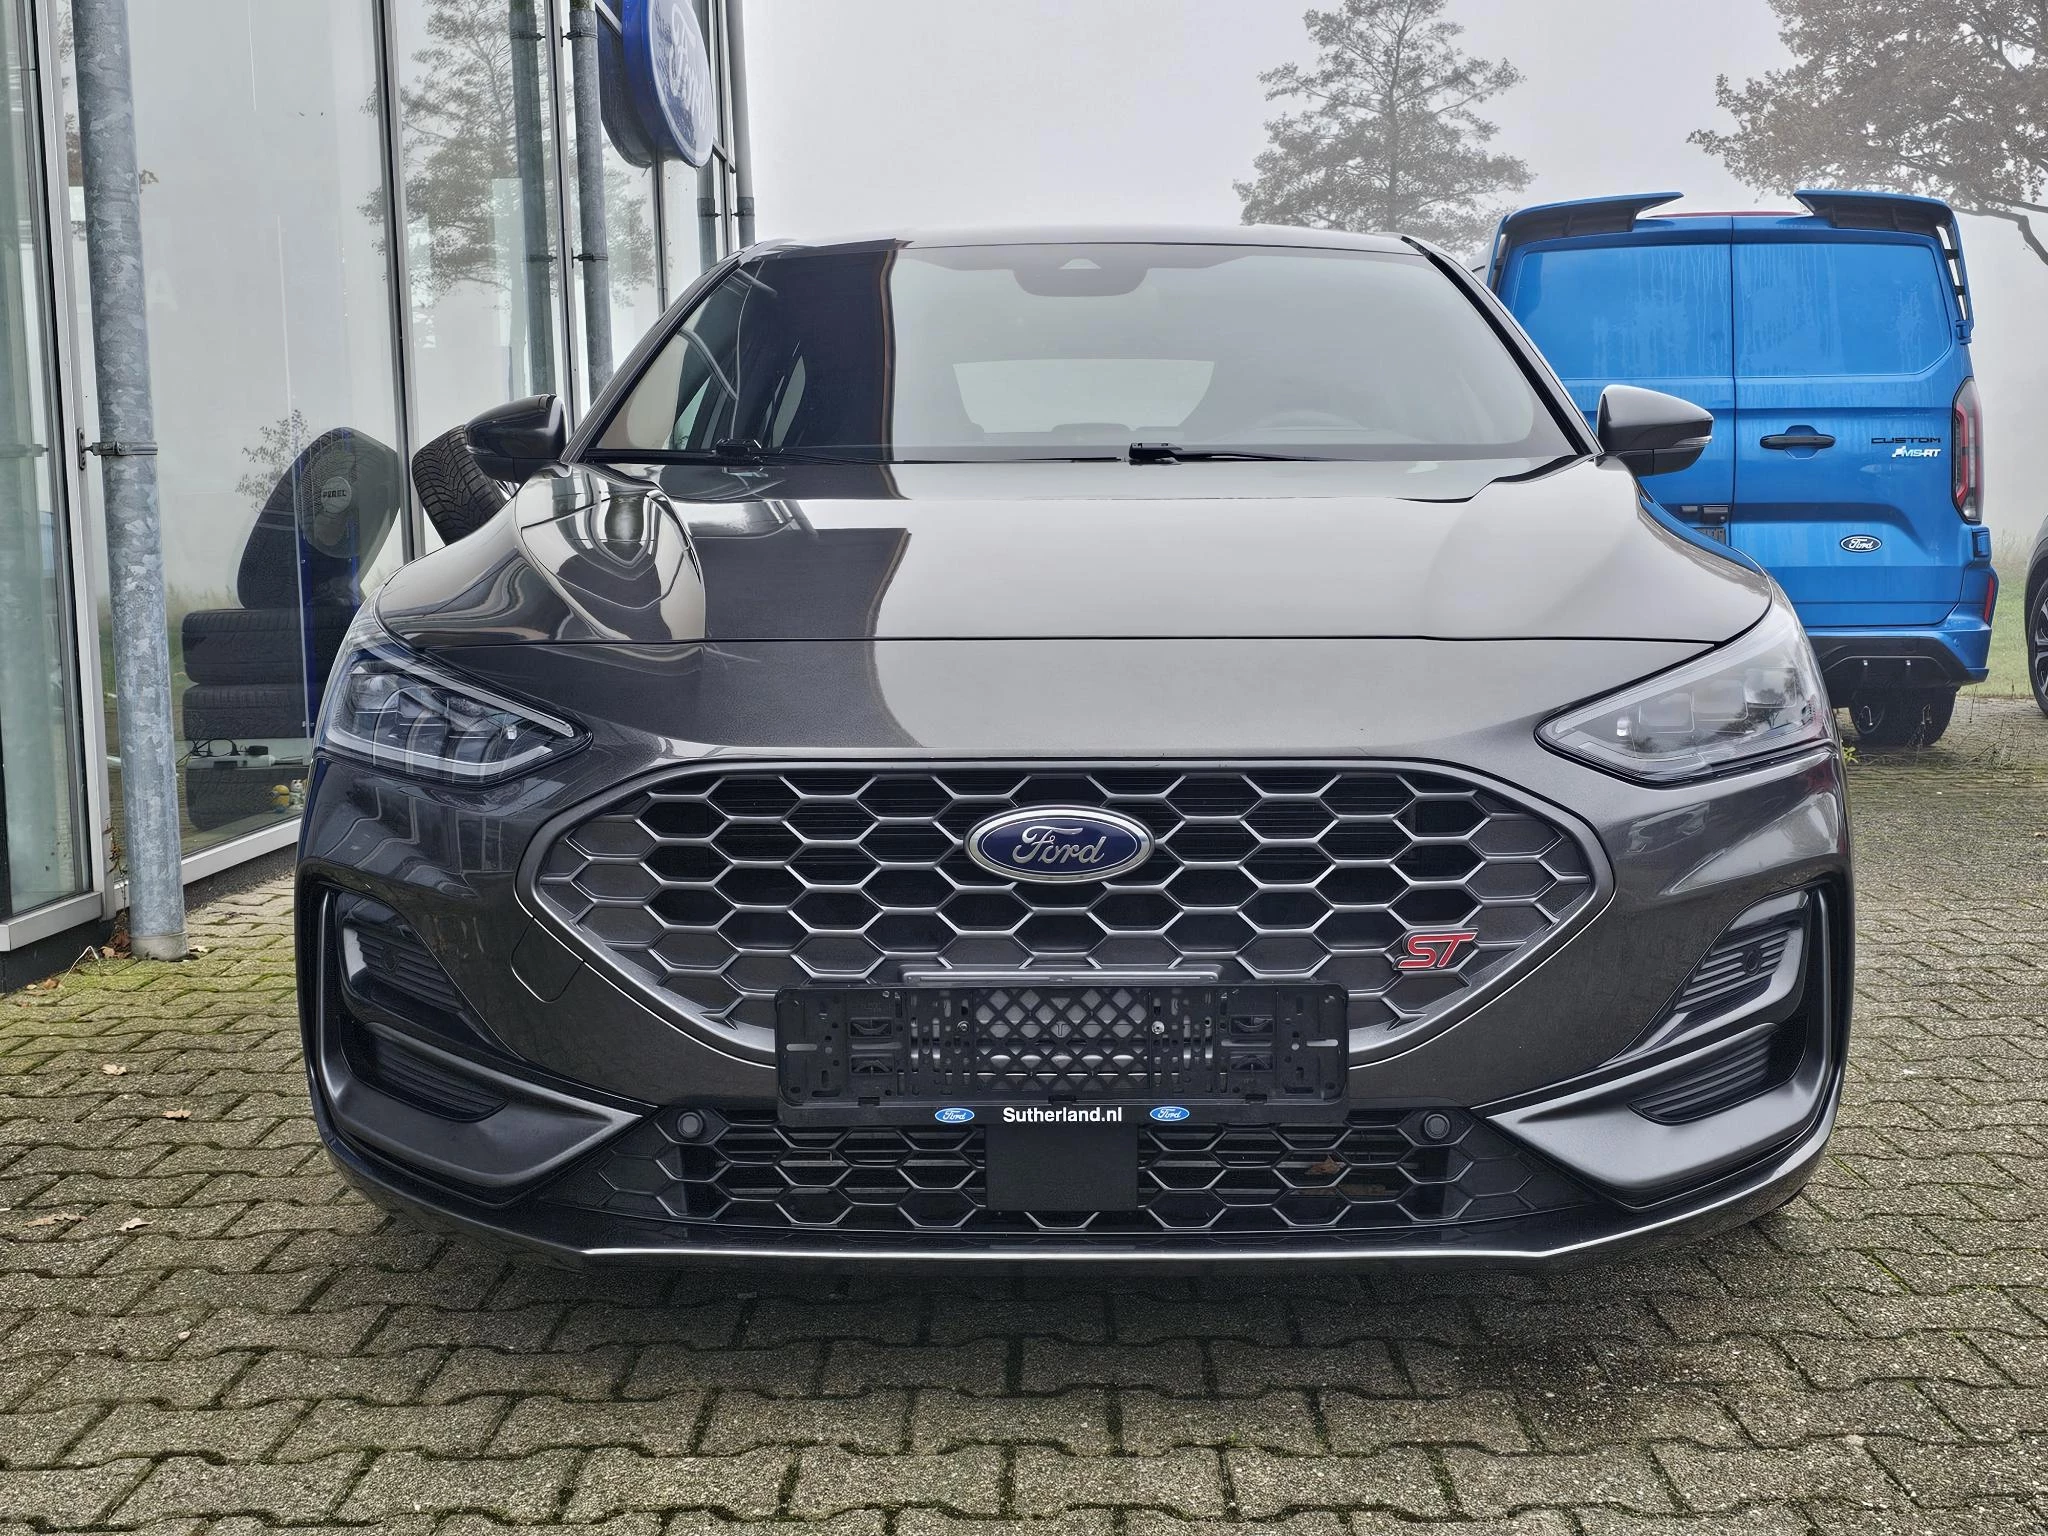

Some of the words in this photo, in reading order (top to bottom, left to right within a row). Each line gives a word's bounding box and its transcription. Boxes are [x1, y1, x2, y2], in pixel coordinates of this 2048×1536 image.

[668, 3, 710, 131] Ford
[1848, 538, 1875, 549] Ford
[1012, 825, 1105, 864] Ford
[1398, 932, 1478, 968] ST
[942, 1110, 967, 1120] Ford
[1003, 1107, 1122, 1122] Sutherland.nl
[1157, 1108, 1182, 1119] Ford
